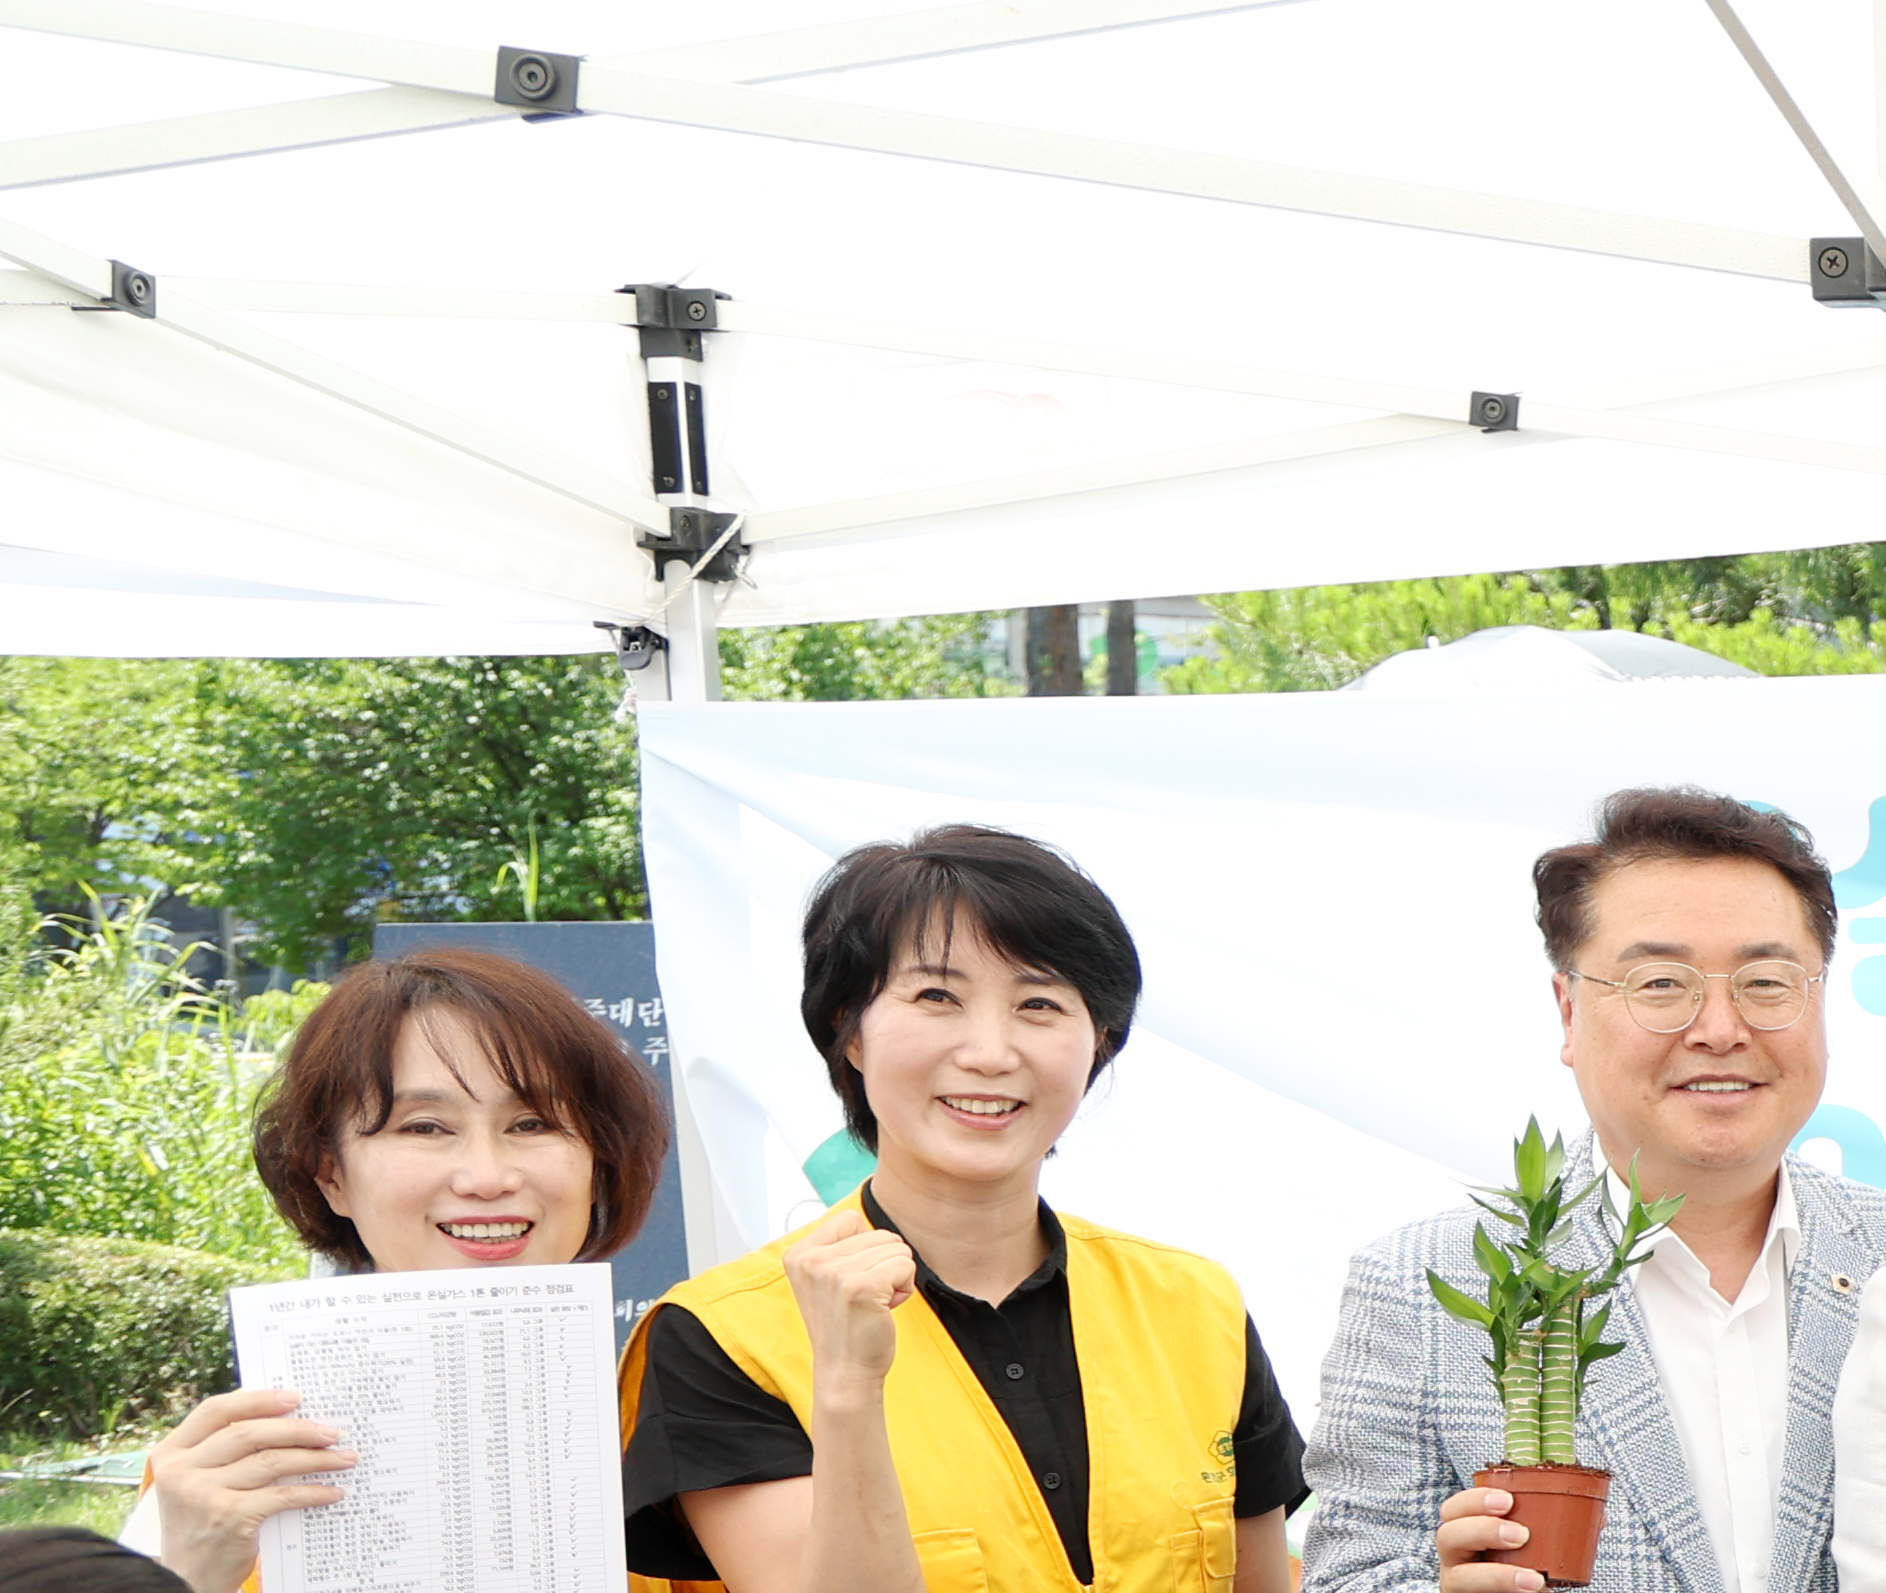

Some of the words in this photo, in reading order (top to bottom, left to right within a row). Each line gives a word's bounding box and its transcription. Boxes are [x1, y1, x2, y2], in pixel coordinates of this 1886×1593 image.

[269, 1301, 294, 1312] 1년간
[299, 1298, 320, 1308] 내가
[325, 1296, 336, 1307] 할
[340, 1295, 351, 1305] 수
[355, 1293, 376, 1304] 있는
[382, 1291, 421, 1302] 실천으로
[427, 1288, 465, 1300] 온실가스
[489, 1285, 517, 1297] 줄이기
[521, 1284, 541, 1295] 준수
[544, 1283, 574, 1294] 점검표
